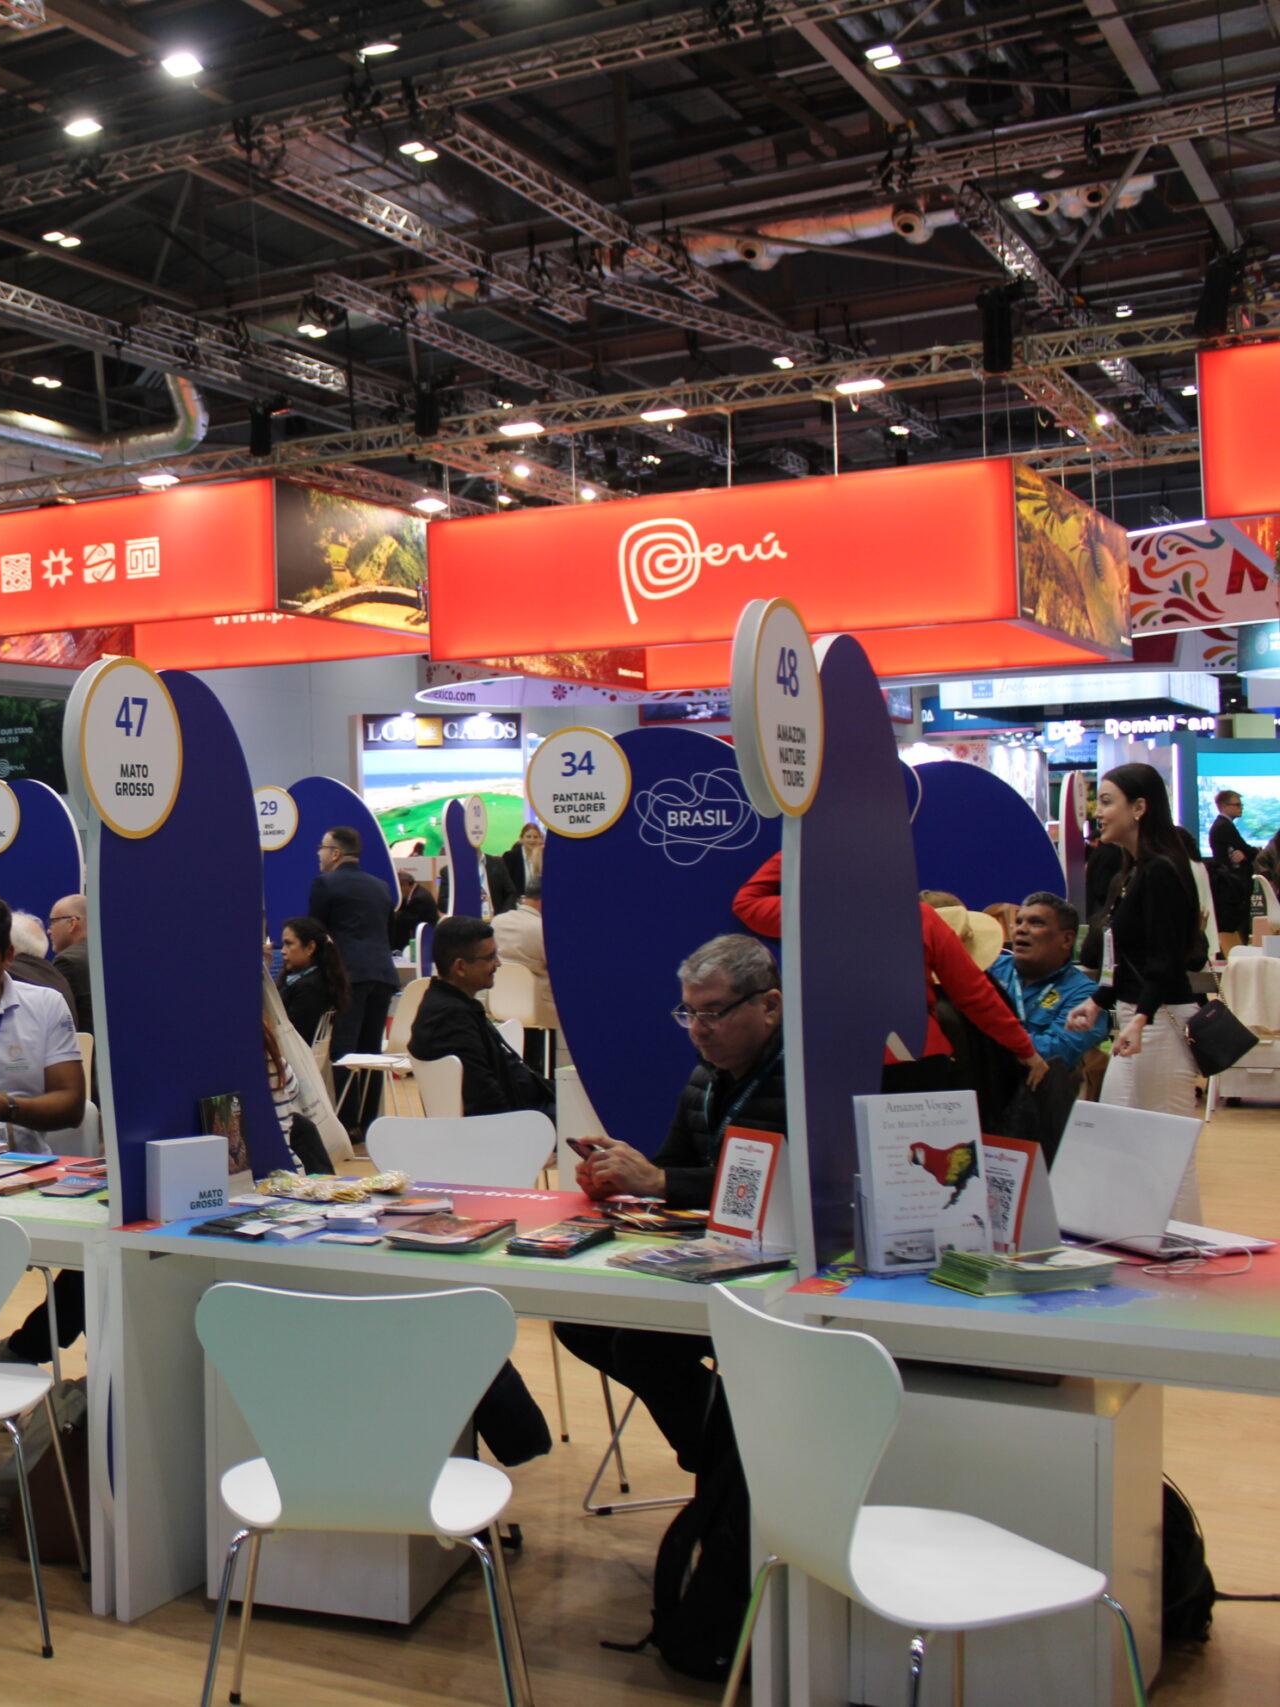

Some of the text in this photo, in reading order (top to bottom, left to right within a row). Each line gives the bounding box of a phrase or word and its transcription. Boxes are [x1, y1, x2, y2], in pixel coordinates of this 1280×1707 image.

[619, 518, 787, 624] Perú
[777, 647, 800, 697] 48
[115, 696, 149, 737] 47
[776, 724, 806, 744] AMAZON
[561, 751, 595, 777] 34
[779, 747, 806, 766] NATURE
[120, 763, 149, 778] MATO
[782, 769, 805, 788] TOURS
[115, 782, 154, 796] GROSSO
[552, 792, 606, 802] PANTANAL
[260, 801, 278, 815] 29
[554, 803, 606, 813] EXPLORER
[569, 815, 591, 824] DMC
[667, 810, 732, 827] BRASIL
[885, 1099, 962, 1114] Amazon Voyages
[199, 1189, 223, 1199] MATO
[190, 1198, 223, 1210] GROSSO
